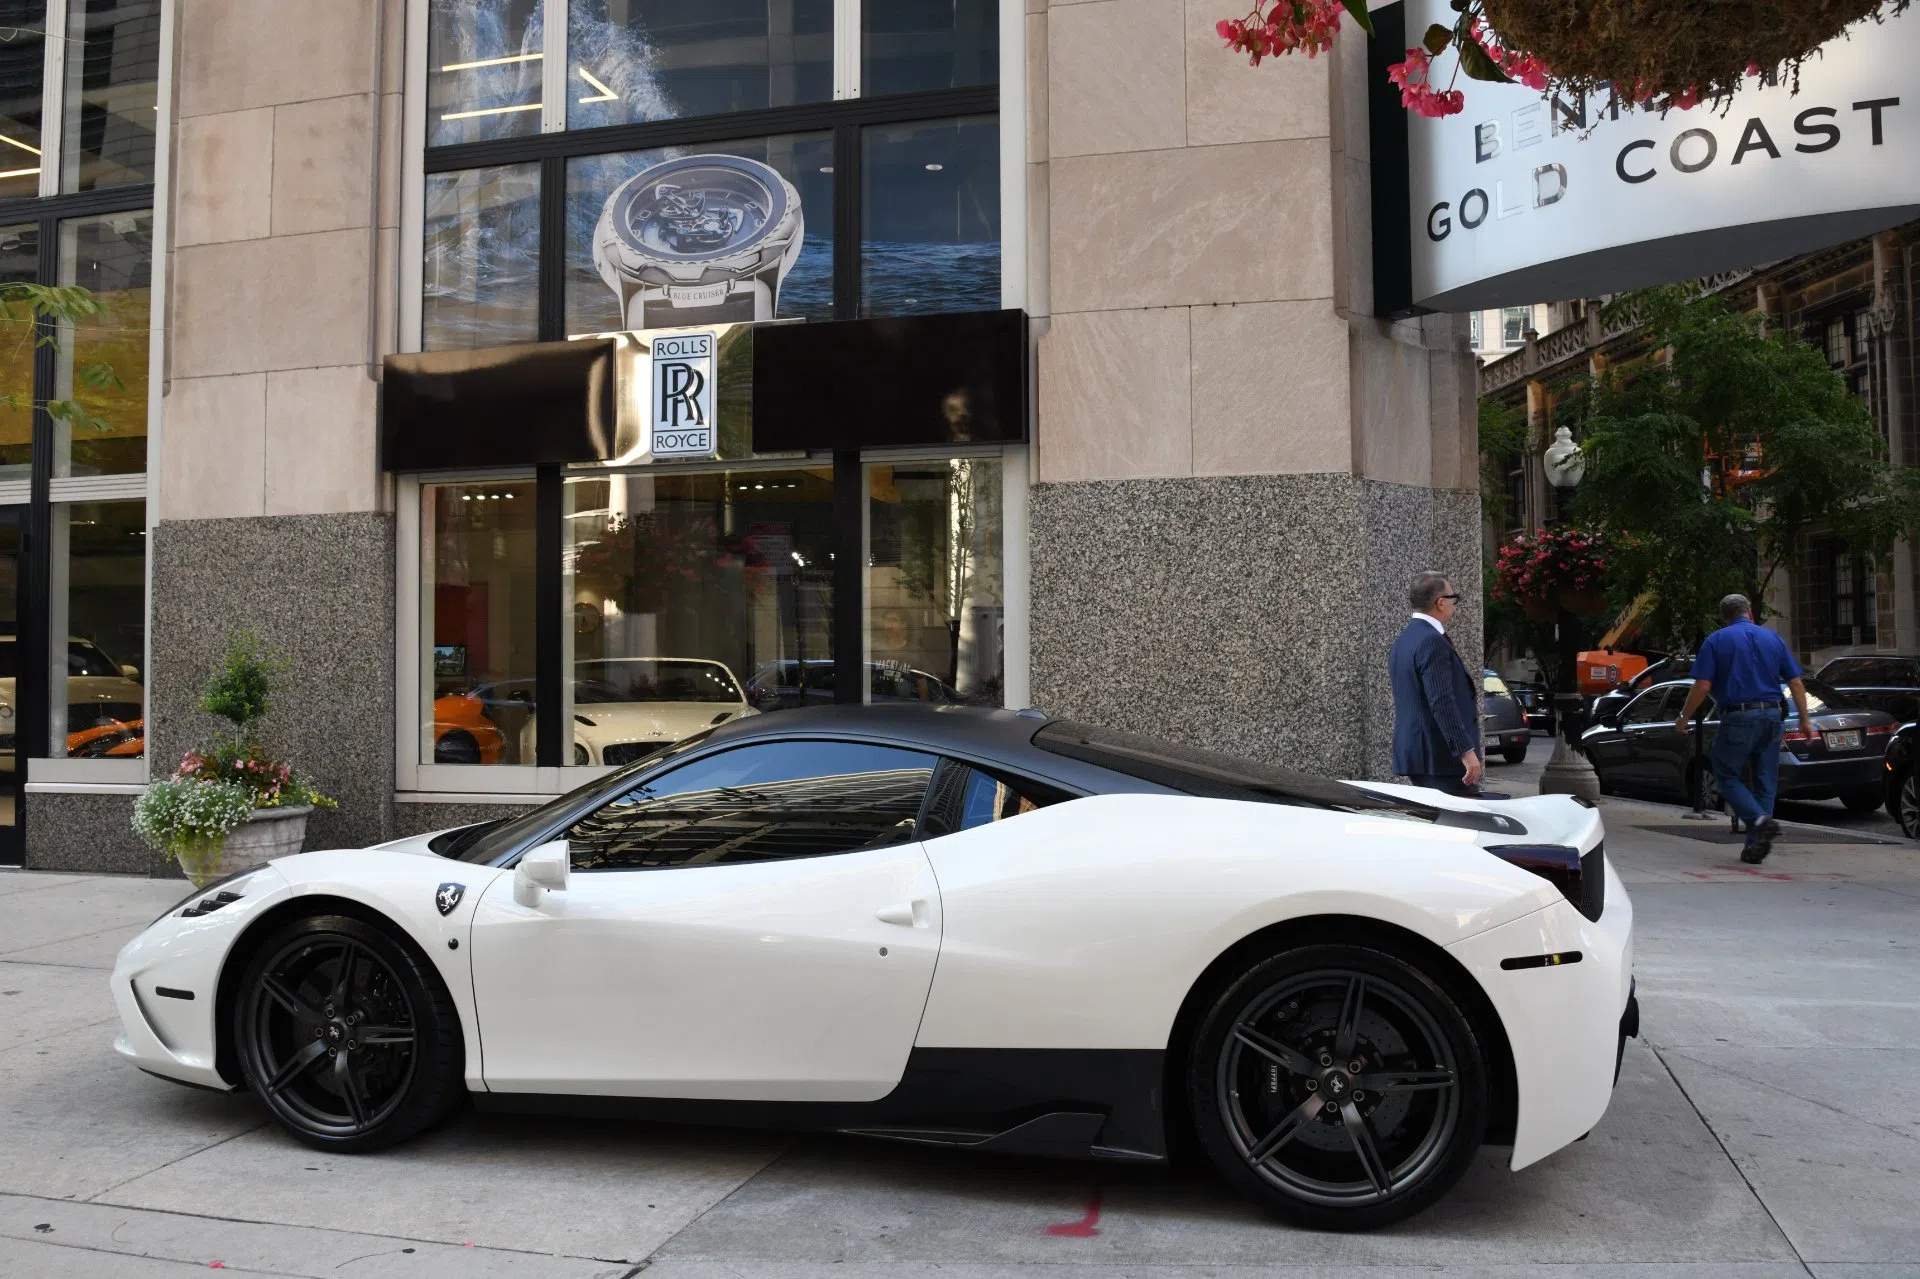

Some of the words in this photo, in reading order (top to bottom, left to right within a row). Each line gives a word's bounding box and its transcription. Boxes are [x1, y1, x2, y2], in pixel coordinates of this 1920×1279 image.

[1426, 162, 1568, 242] GOLD
[1615, 96, 1900, 184] COAST
[673, 291, 691, 301] BLUE
[693, 289, 725, 301] CRUISER
[656, 339, 708, 357] ROLLS
[655, 432, 707, 449] ROYCE
[879, 675, 905, 683] ISLND
